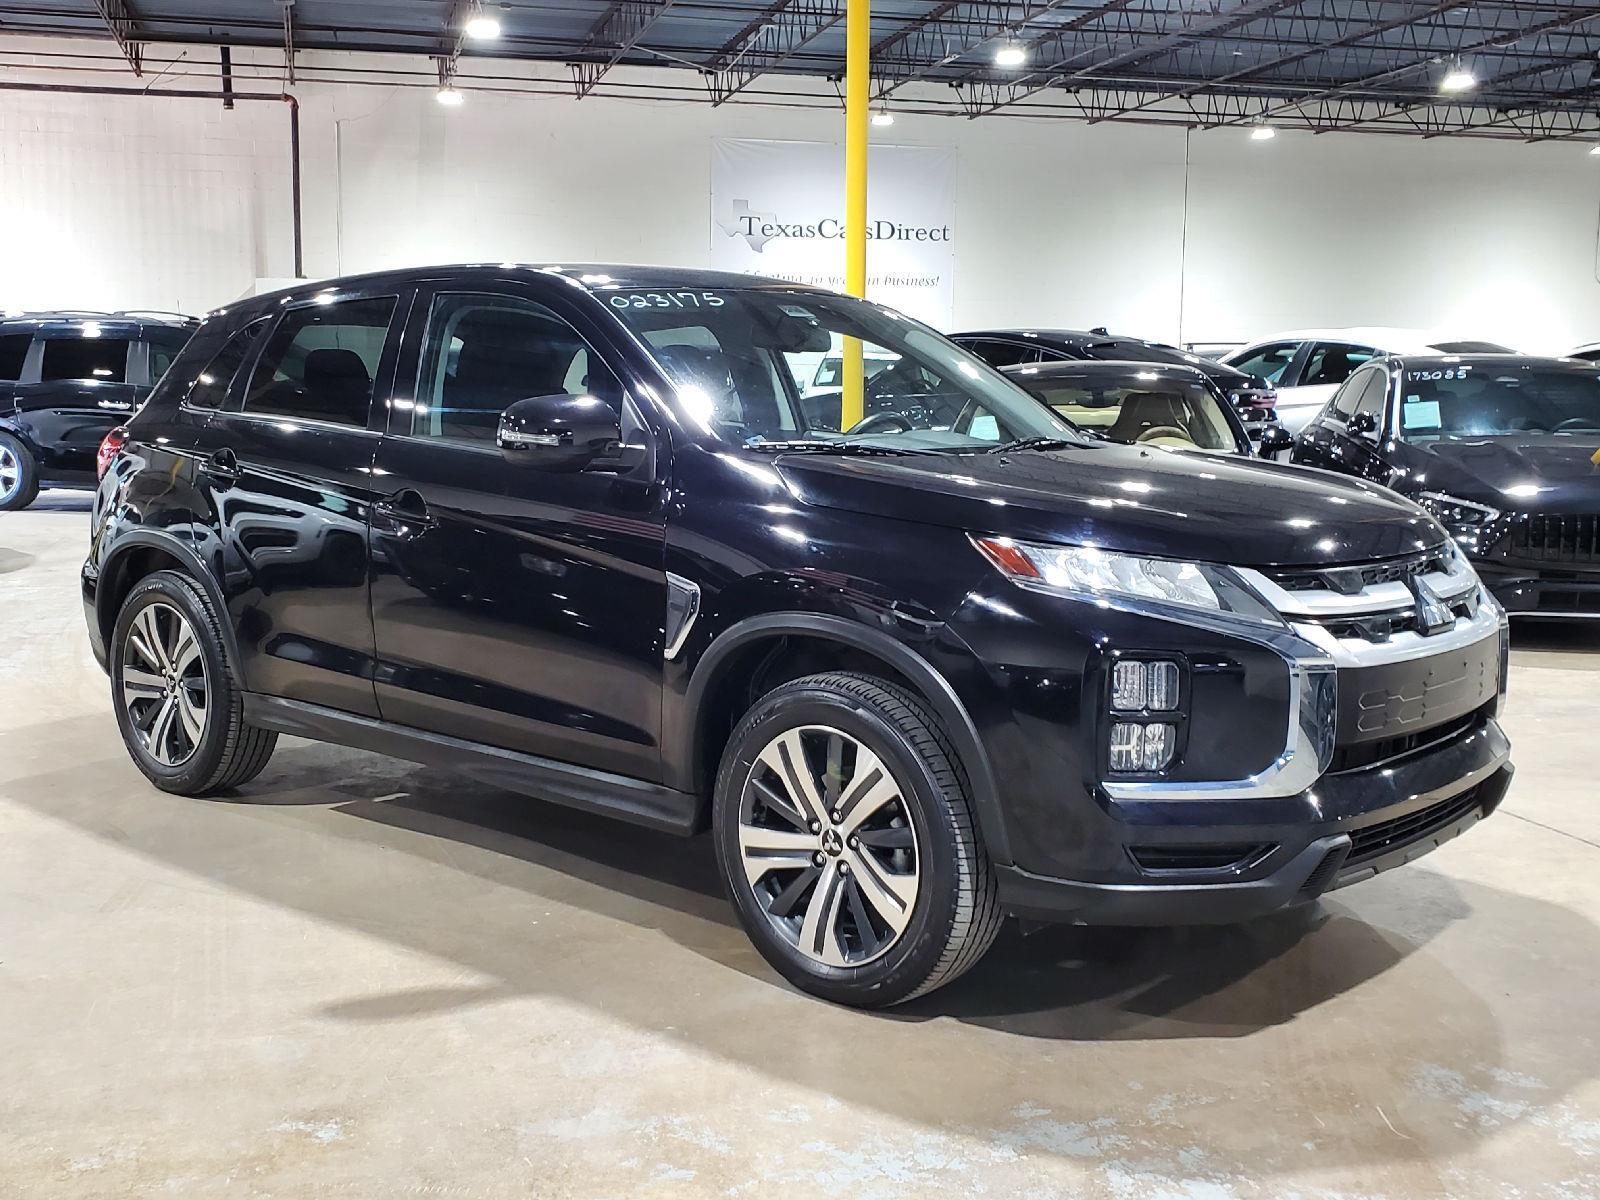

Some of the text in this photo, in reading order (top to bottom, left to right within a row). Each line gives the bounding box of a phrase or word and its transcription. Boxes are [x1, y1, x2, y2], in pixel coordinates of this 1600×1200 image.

[739, 216, 950, 241] TexasCasDirect
[884, 273, 940, 287] business!
[610, 292, 724, 308] 023175
